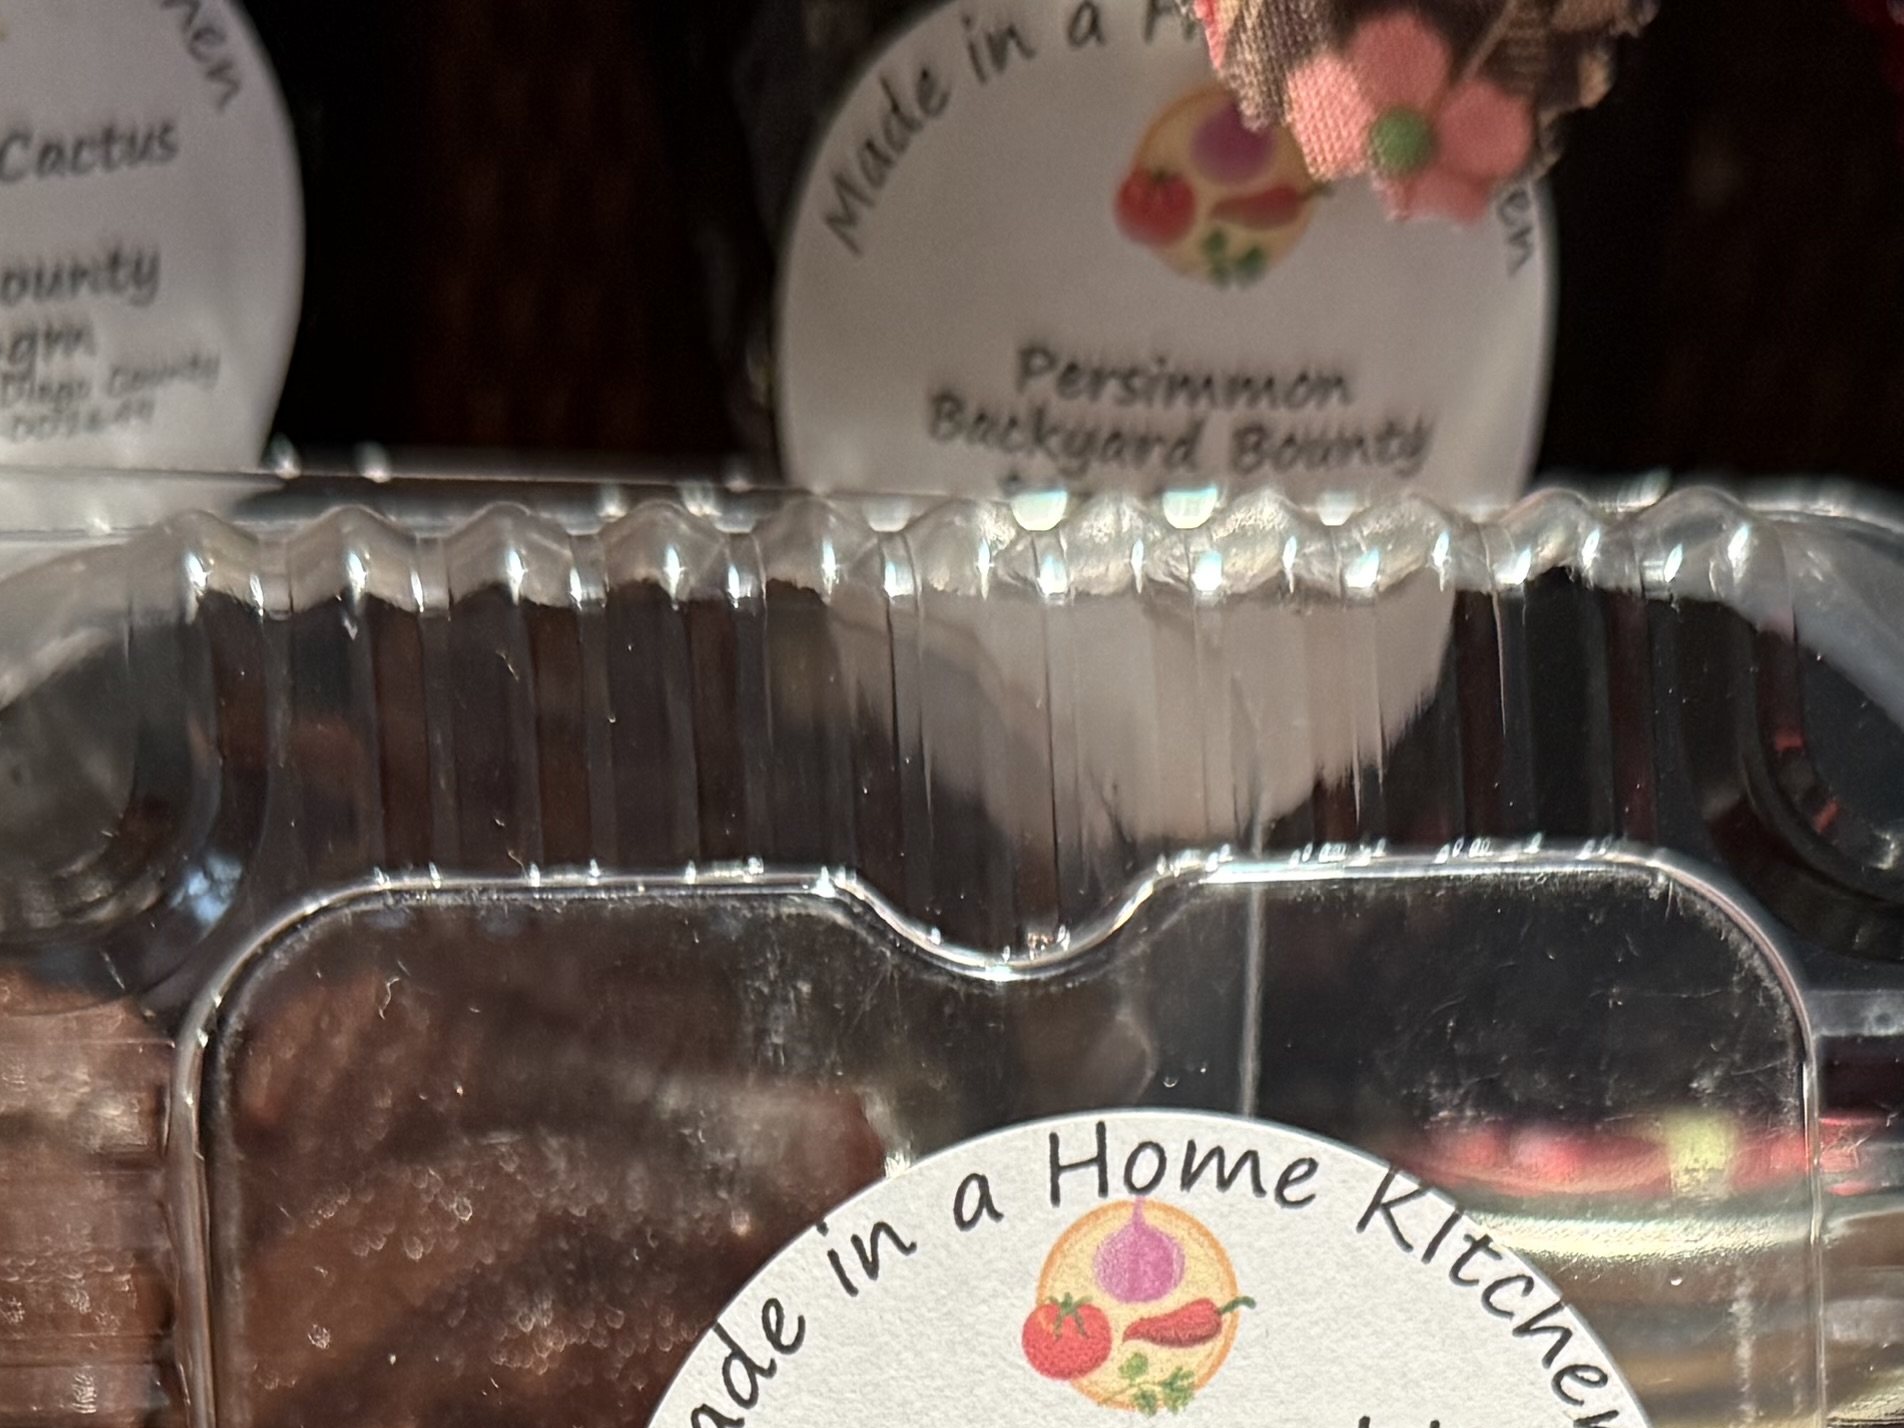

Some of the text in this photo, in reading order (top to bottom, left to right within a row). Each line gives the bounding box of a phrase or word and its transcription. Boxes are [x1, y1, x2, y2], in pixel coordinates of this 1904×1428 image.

[821, 62, 953, 257] Made
[962, 12, 1036, 84] in
[1065, 0, 1106, 49] a
[928, 390, 1434, 477] Backyard Bounty
[1016, 344, 1351, 411] Persimmon
[815, 1220, 917, 1297] in
[953, 1172, 1004, 1232] a
[1049, 1120, 1320, 1209] Home
